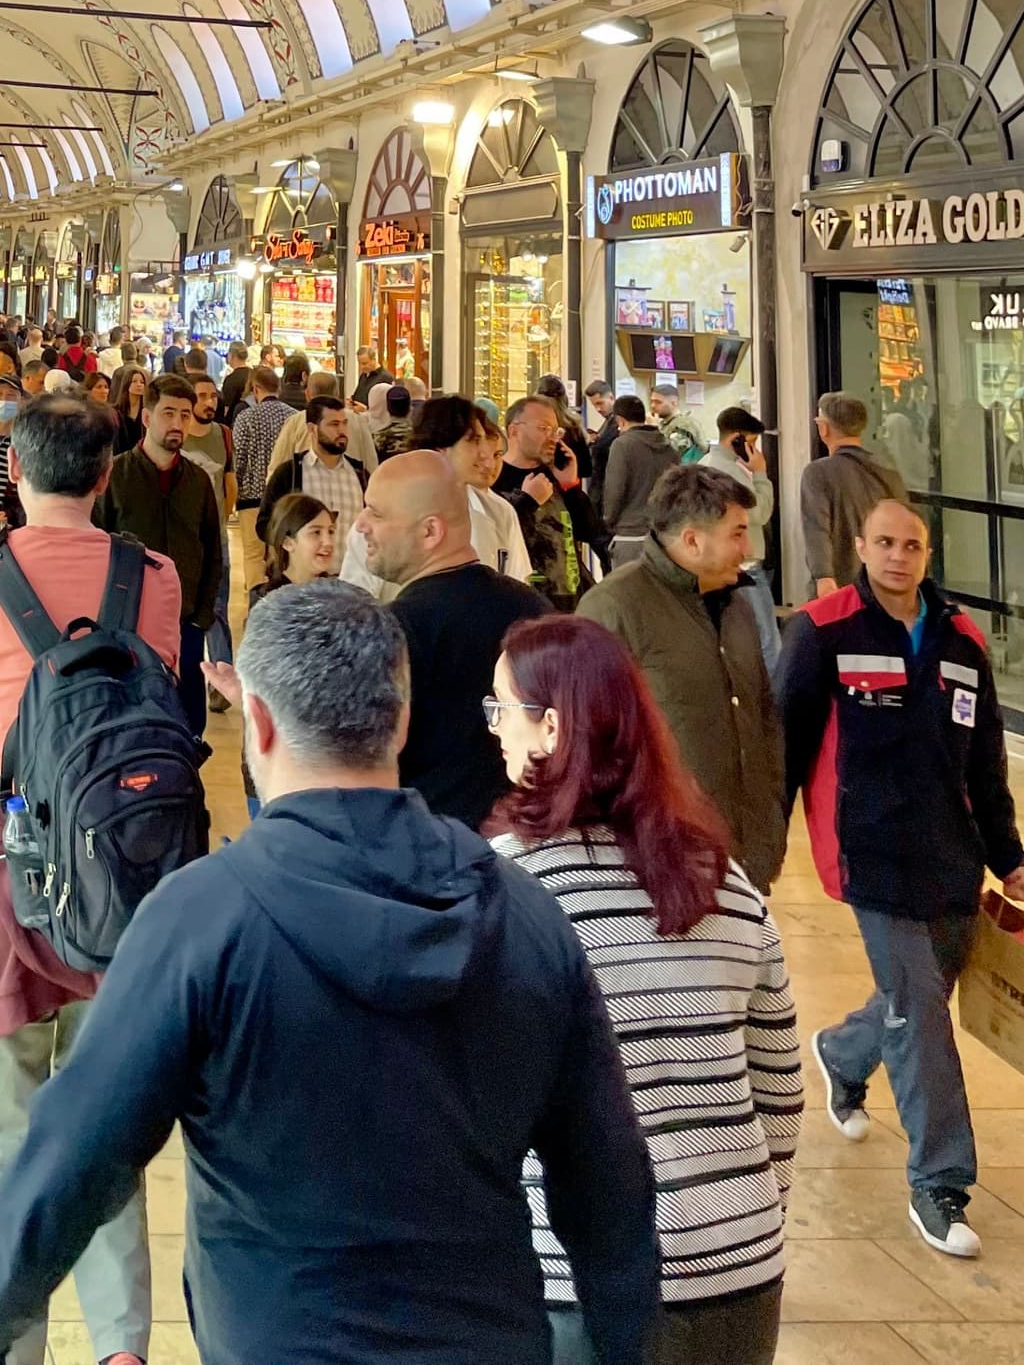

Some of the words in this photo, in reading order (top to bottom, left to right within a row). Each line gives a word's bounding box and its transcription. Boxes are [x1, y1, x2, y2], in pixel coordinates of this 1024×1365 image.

[615, 166, 717, 203] PHOTTOMAN
[631, 213, 666, 229] COSTUME
[667, 210, 693, 226] PHOTO
[852, 193, 937, 248] ELİZA
[942, 189, 1024, 244] GOLD
